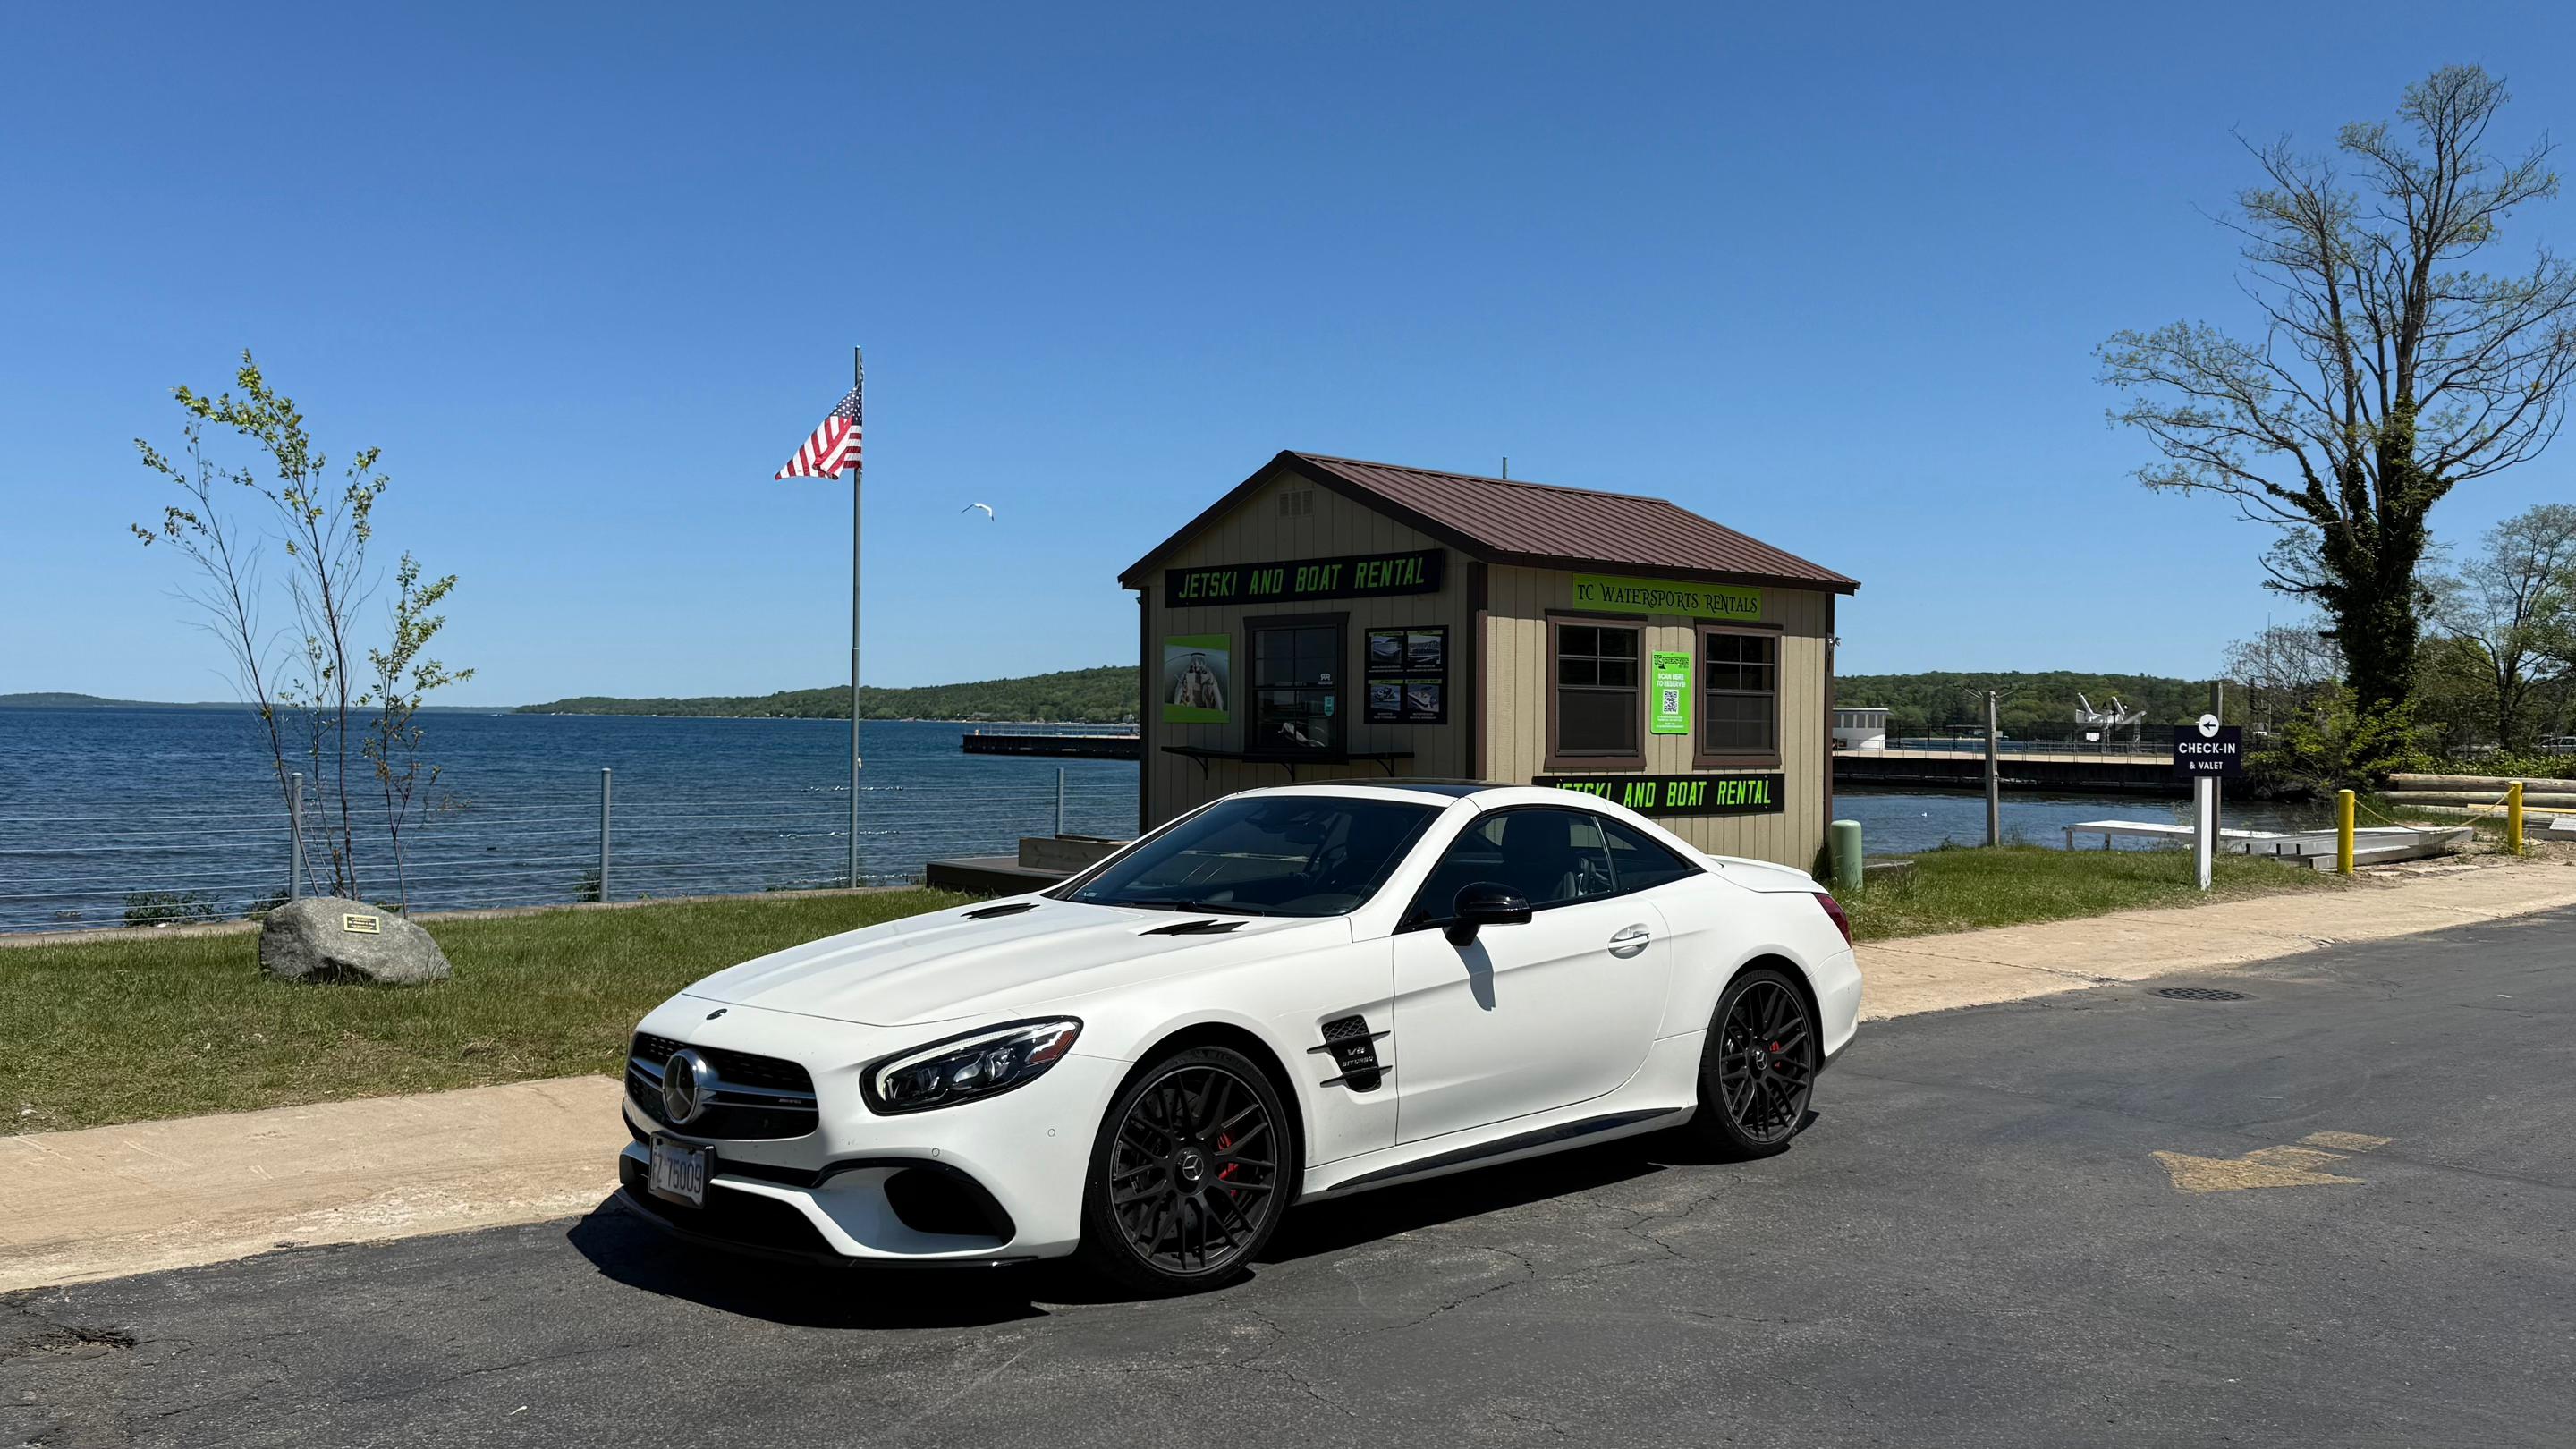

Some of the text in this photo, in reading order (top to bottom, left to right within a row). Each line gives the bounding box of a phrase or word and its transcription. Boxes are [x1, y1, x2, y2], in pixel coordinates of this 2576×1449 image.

[1179, 557, 1425, 598] JETSKI AND BOAT RENTAL
[1577, 583, 1758, 614] TC WATERSPORTS RENTALS
[2178, 742, 2236, 754] CHECK-IN
[2189, 761, 2224, 770] & VALET
[1623, 782, 1657, 808] AND
[1666, 781, 1707, 807] BOAT
[1716, 780, 1771, 806] RENTAL
[1347, 1046, 1366, 1055] V8
[1342, 1055, 1374, 1067] BITURBO
[667, 1157, 701, 1193] 75009
